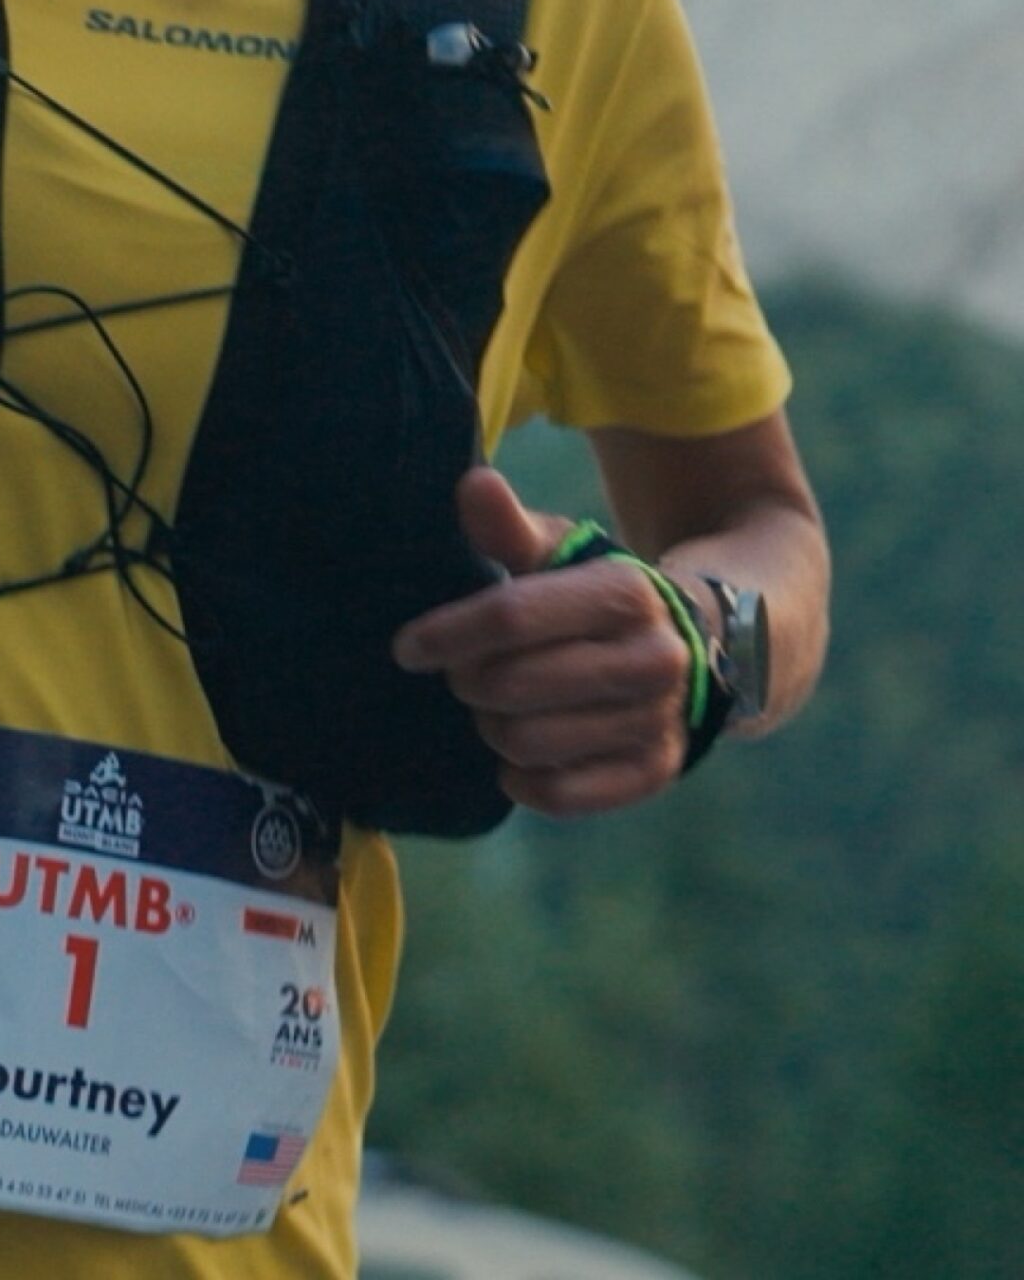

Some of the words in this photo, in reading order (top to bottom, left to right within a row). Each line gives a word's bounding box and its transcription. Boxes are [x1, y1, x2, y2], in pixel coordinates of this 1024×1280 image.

[85, 8, 299, 62] SALOMON
[61, 795, 141, 836] UTMB
[66, 933, 99, 1029] 1
[279, 982, 324, 1022] 20
[275, 1022, 322, 1048] ANS
[0, 1118, 112, 1157] DAUWALTER
